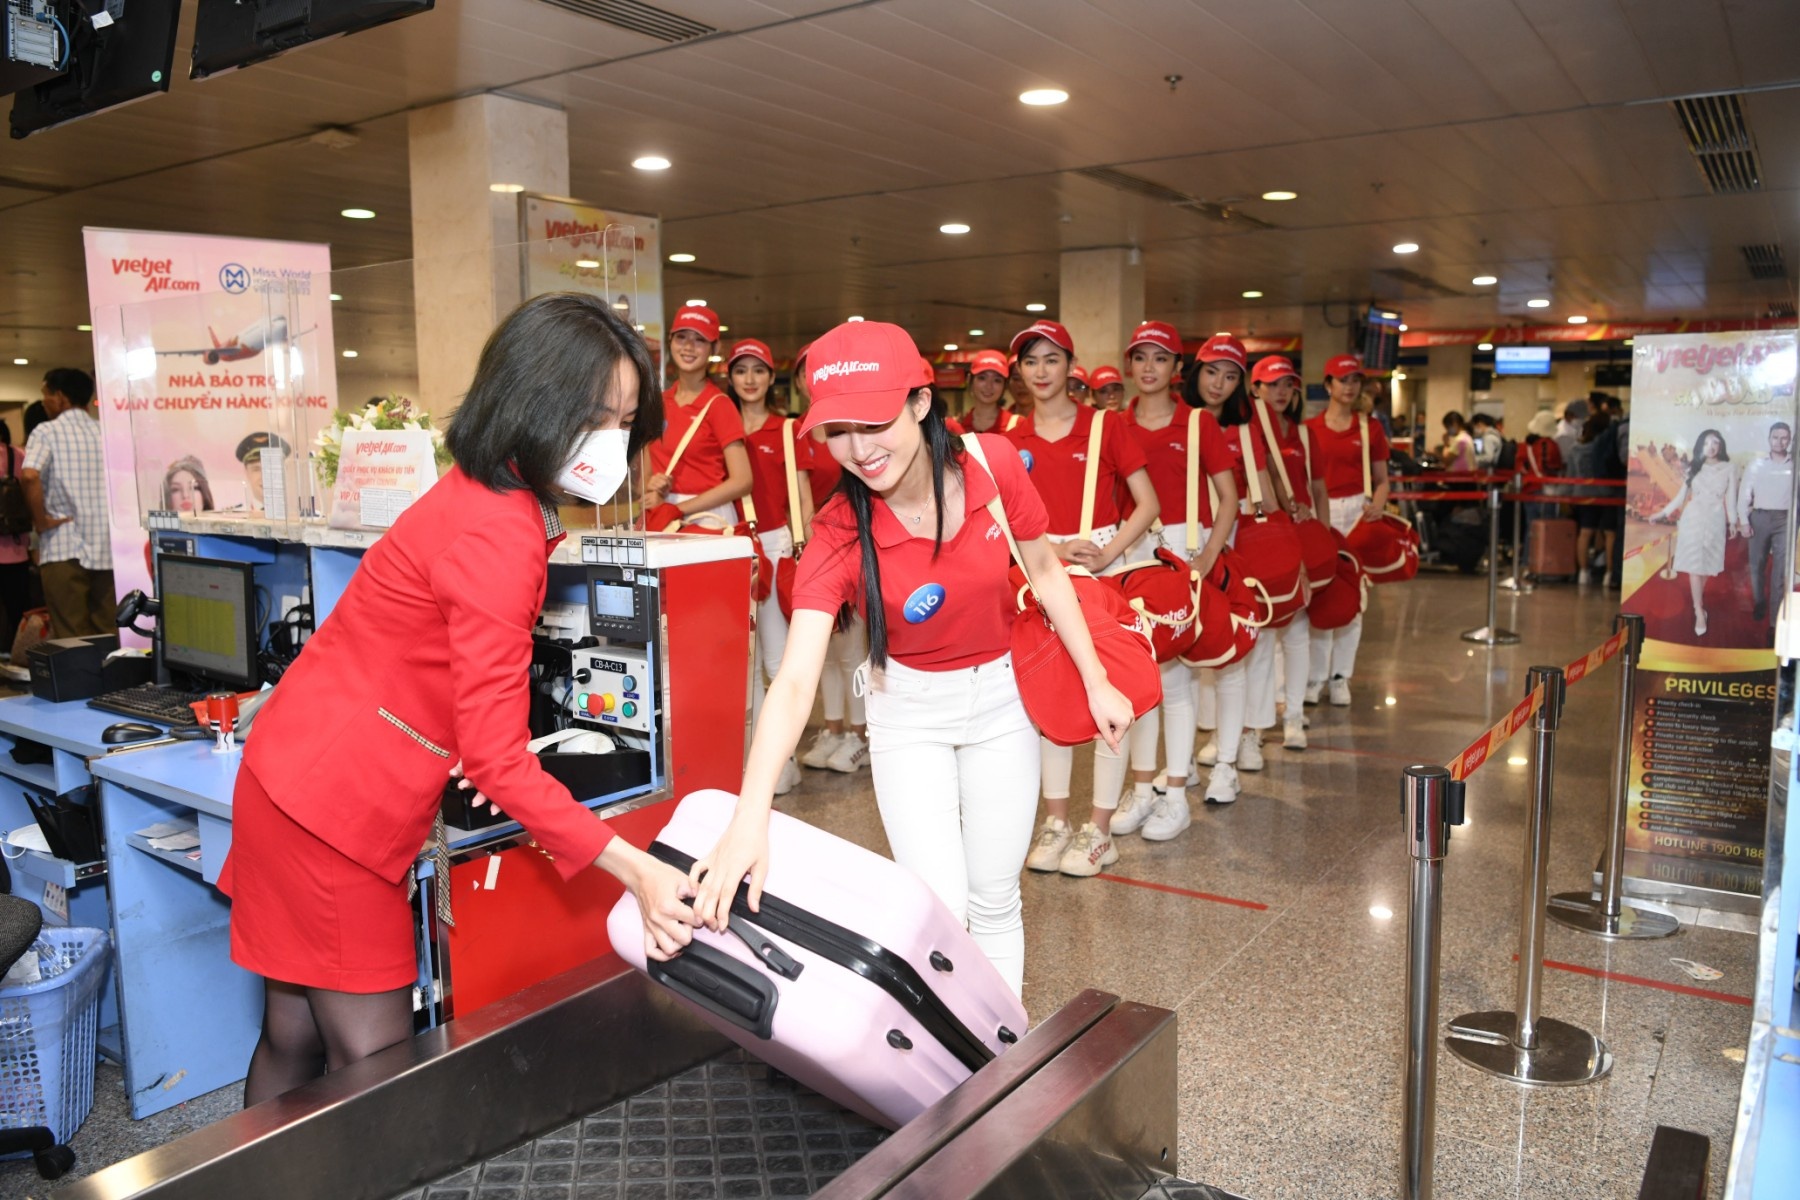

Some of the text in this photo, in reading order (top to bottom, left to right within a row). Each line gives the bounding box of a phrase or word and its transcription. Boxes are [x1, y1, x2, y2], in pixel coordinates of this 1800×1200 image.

[169, 372, 205, 387] NHÀ
[210, 370, 243, 387] BẢO
[913, 594, 939, 616] 116
[1664, 677, 1776, 700] PRIVILEGES
[1654, 836, 1708, 851] HOTLINE
[1711, 843, 1741, 856] 1900
